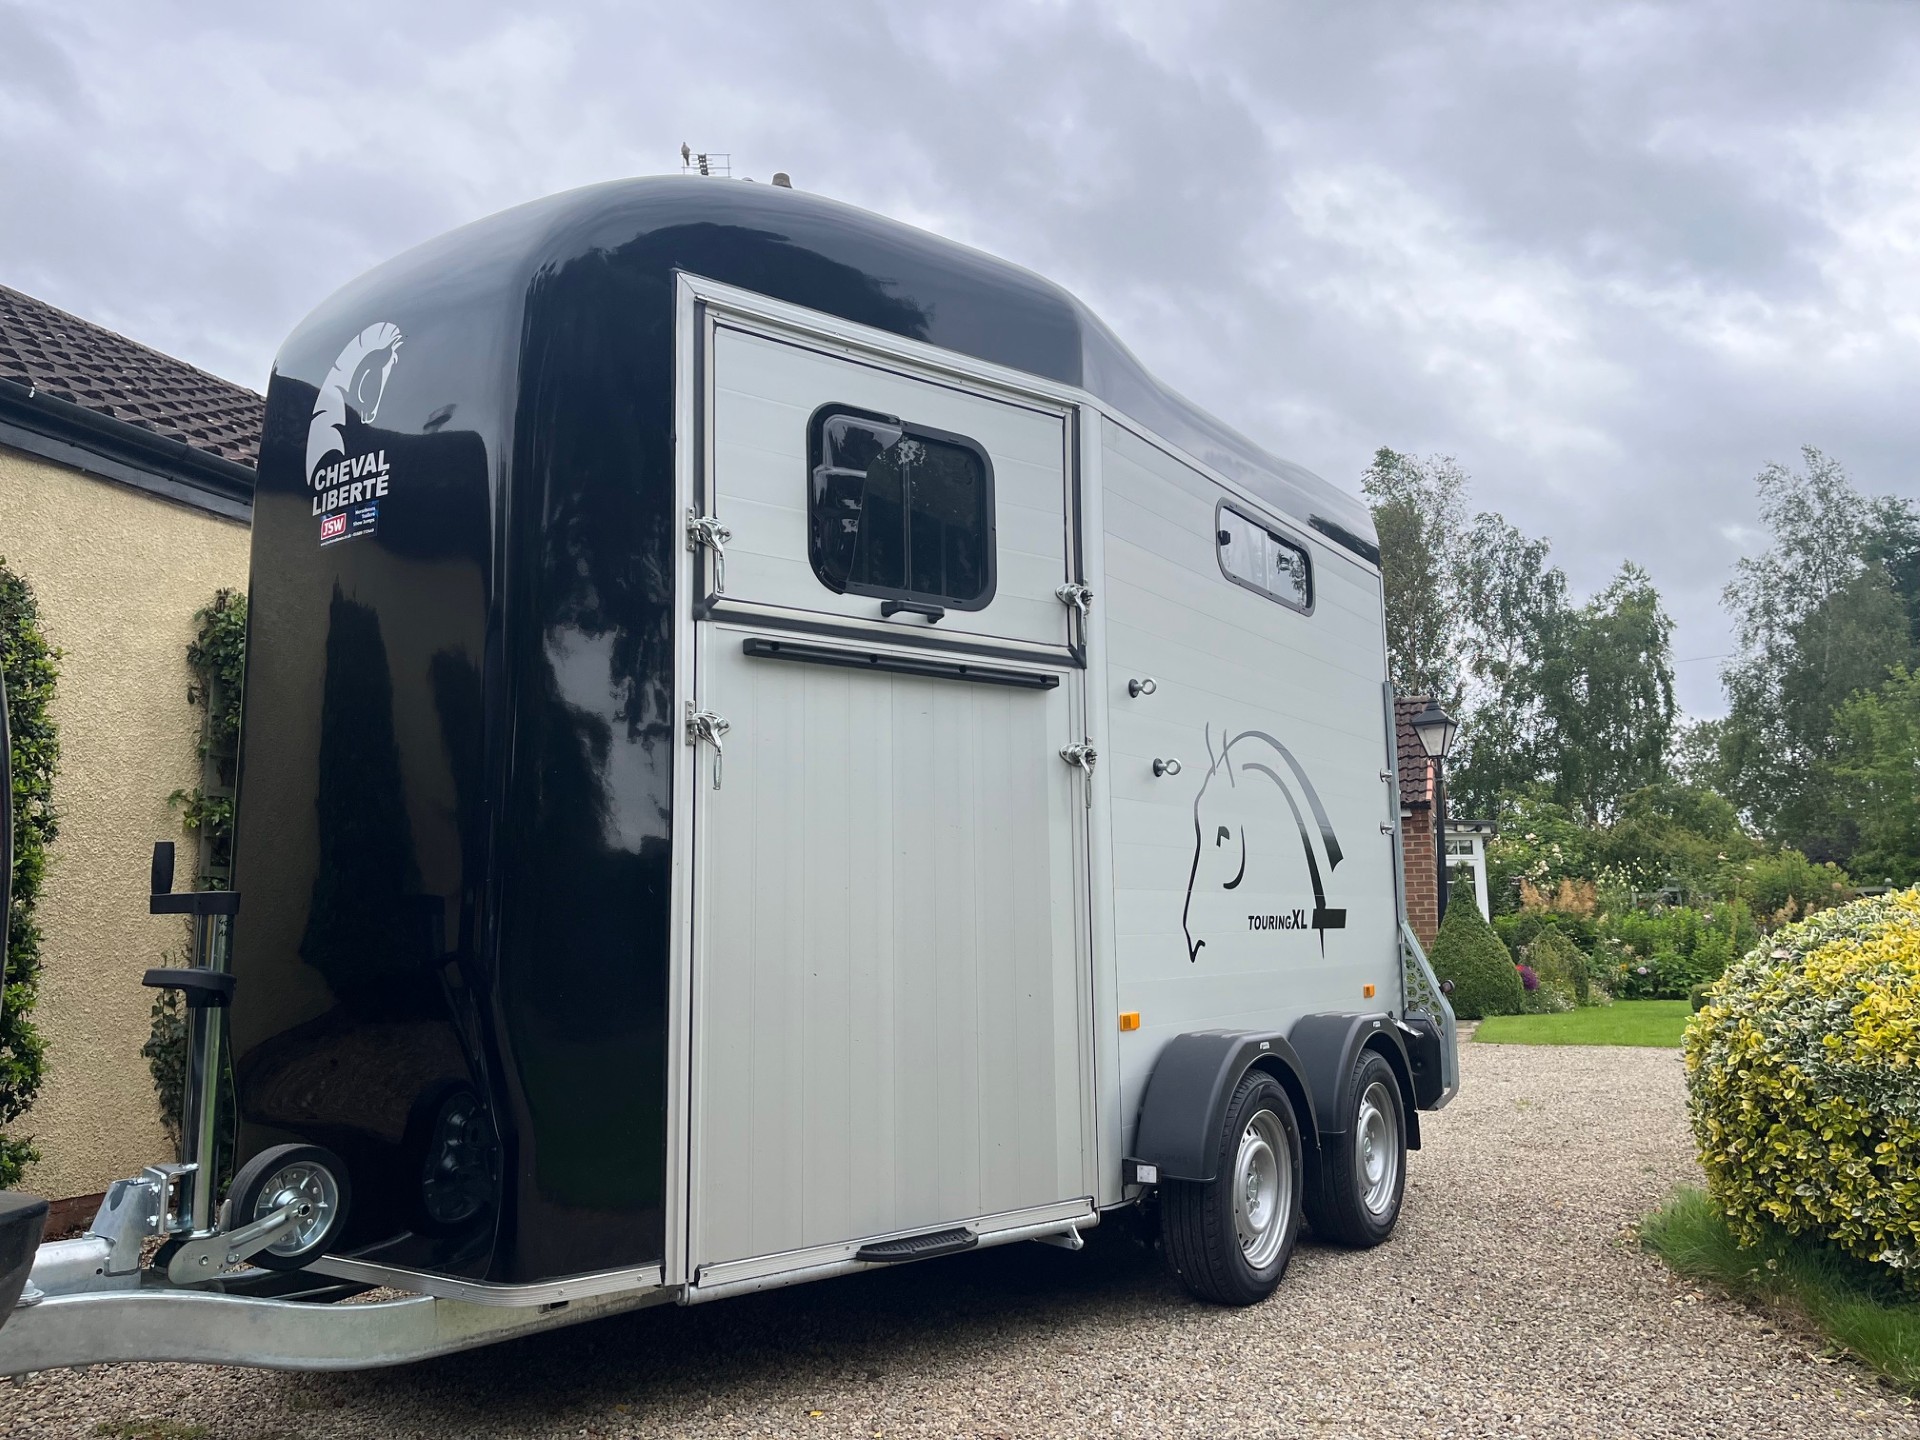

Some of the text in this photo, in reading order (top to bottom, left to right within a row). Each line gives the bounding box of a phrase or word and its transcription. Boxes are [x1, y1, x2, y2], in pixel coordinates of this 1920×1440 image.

[314, 449, 390, 491] CHEVAL
[312, 470, 390, 516] LIBERTÉ
[322, 517, 344, 536] JSW
